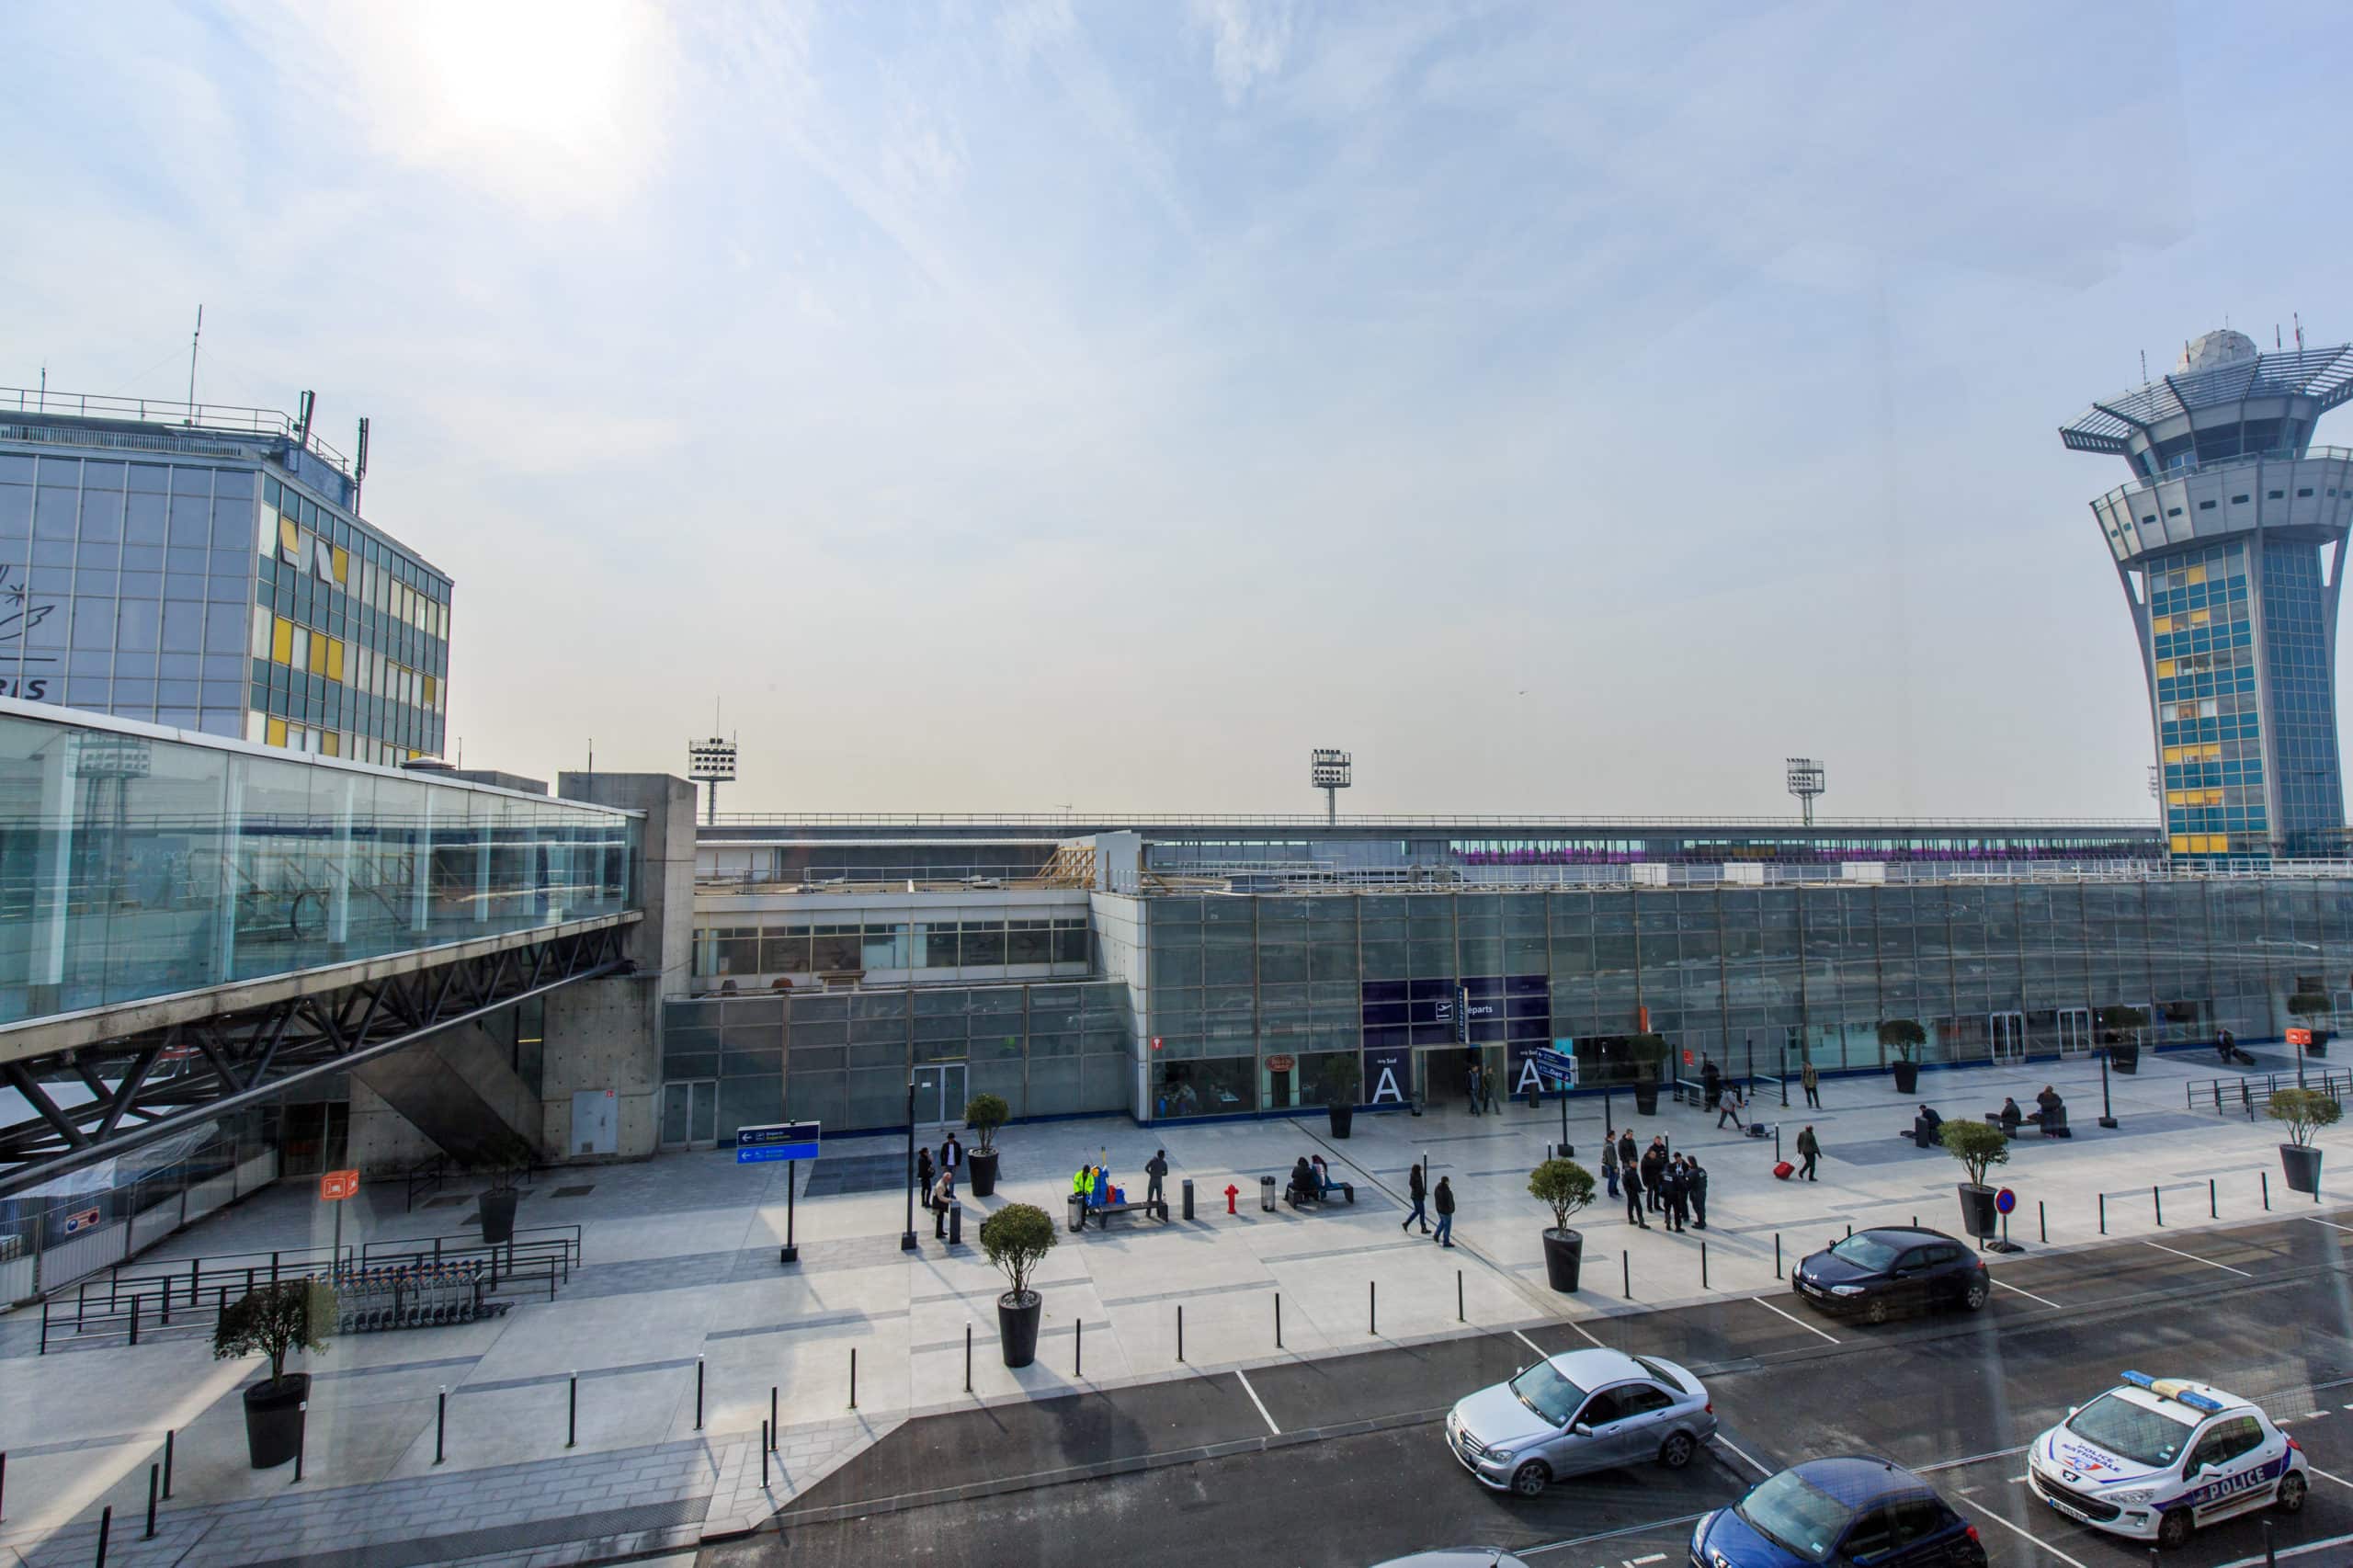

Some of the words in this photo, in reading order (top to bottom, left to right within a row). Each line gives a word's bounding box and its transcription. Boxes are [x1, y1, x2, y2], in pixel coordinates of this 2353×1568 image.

[1467, 1005, 1494, 1016] éparts
[1371, 1067, 1404, 1104] A
[1516, 1058, 1545, 1094] A
[2061, 1443, 2122, 1472] NATIONALE
[2077, 1443, 2115, 1462] POLICE
[2209, 1467, 2266, 1500] POLICE
